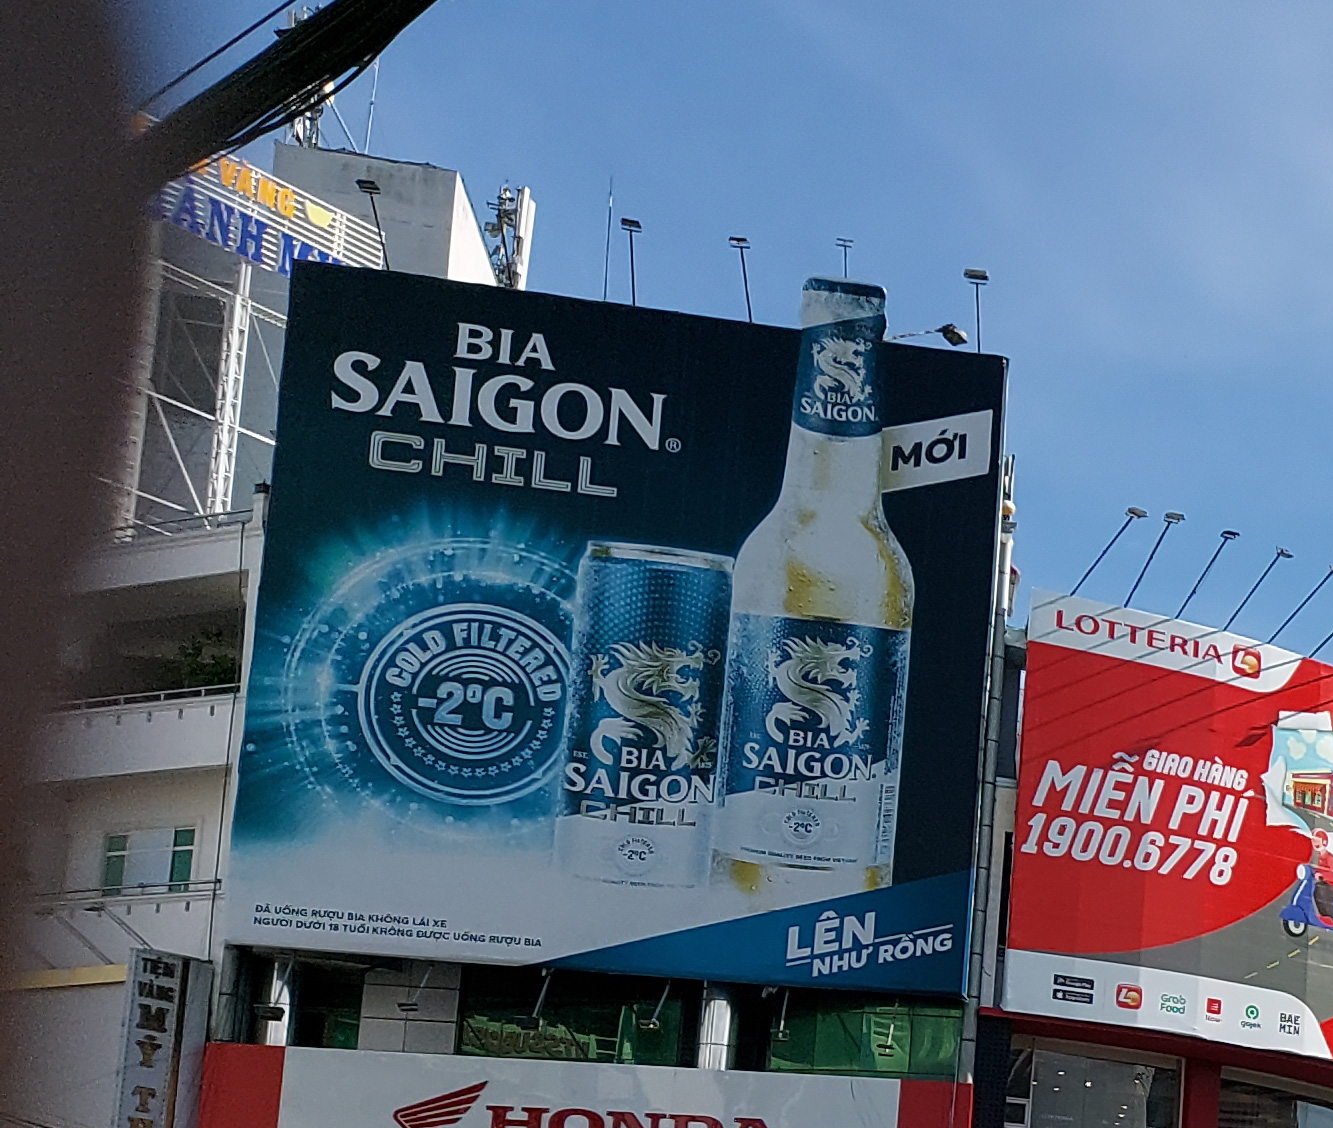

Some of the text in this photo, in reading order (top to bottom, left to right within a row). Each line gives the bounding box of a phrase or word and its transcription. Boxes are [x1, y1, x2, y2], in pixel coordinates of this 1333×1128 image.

[454, 322, 556, 372] BIA
[331, 350, 667, 452] SAIGON
[800, 396, 876, 422] SAIGON
[827, 391, 852, 405] BIA
[368, 430, 618, 498] CHILL
[890, 428, 968, 472] MỚI
[1055, 608, 1223, 665] LOTTERIA
[385, 622, 562, 702] COLD FILTERED
[620, 746, 667, 771] BIA
[788, 729, 831, 749] BIA
[742, 742, 873, 780] SAIGON
[1143, 748, 1249, 790] GIAO HÀNG
[563, 762, 716, 804] SAIGON
[754, 775, 857, 802] CHILL
[1031, 750, 1254, 842] MIỄN PHÍ
[579, 799, 697, 827] CHILL
[1020, 812, 1238, 886] 1900.6778
[253, 916, 293, 928] NGƯỜI
[295, 918, 326, 931] DƯỚI
[328, 923, 340, 932] 18
[342, 921, 370, 934] TUỔI
[372, 924, 414, 938] KHÔNG
[452, 929, 486, 943] UỐNG
[523, 937, 542, 948] BIA
[255, 901, 448, 929] ĐÃ UỐNG RƯỢU BIA KHÔNG LÁI XE
[786, 908, 878, 966] LÊN
[811, 923, 954, 977] NHƯ RỒNG
[1160, 993, 1187, 1015] Grab Food
[1279, 1012, 1301, 1025] BAE
[1278, 1023, 1301, 1036] MIN
